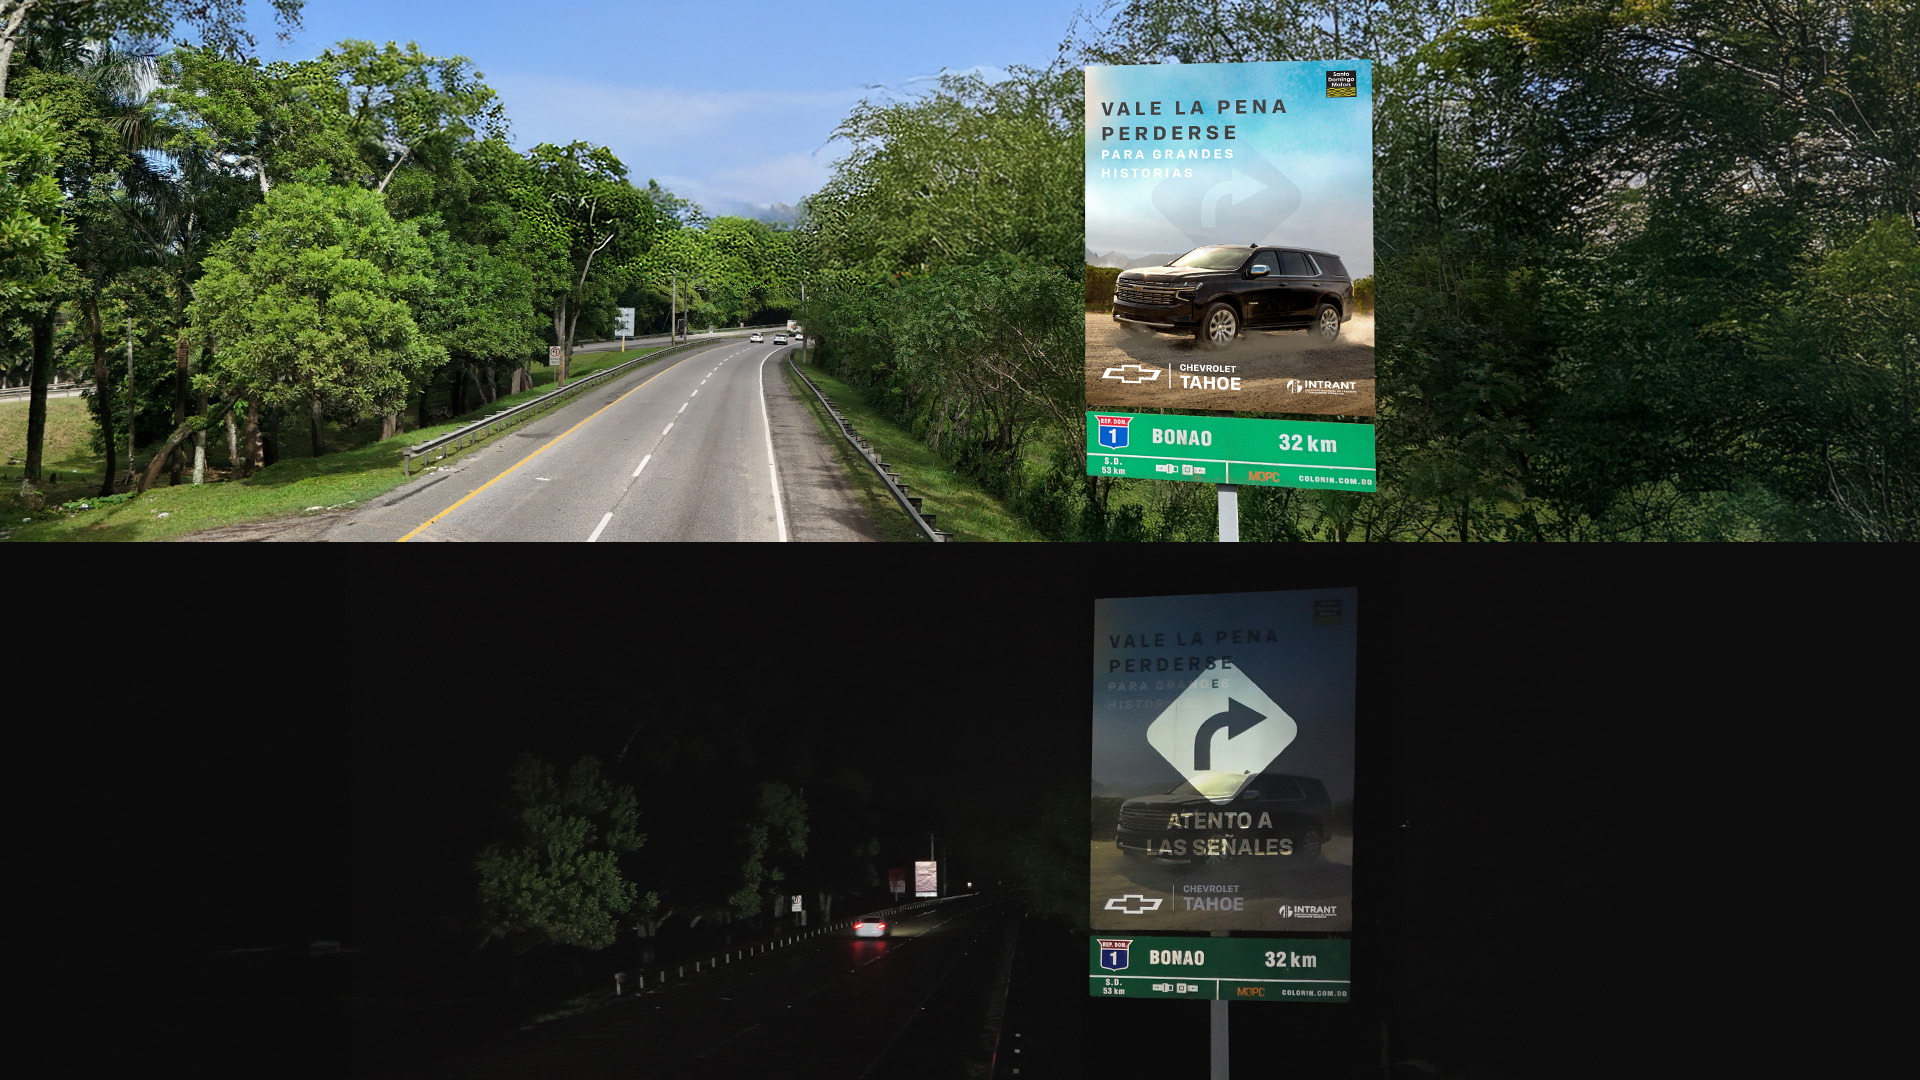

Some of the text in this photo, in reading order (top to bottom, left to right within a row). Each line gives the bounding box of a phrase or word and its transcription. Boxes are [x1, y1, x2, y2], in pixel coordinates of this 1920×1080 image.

[1102, 99, 1287, 116] VALE LA PENA
[1102, 125, 1237, 141] PERDERSE
[1102, 148, 1234, 160] PARA GRANDES
[1102, 168, 1193, 178] HISTORIAS
[1180, 364, 1236, 373] CHEVROLET
[1180, 375, 1241, 390] TAHOE
[1305, 380, 1356, 390] INTRANT
[1108, 428, 1117, 443] 1
[1152, 428, 1337, 453] BONAO 32 km
[1104, 457, 1123, 465] S.D.
[1102, 466, 1125, 475] 53 km
[1249, 471, 1372, 486] MOPC COLORIN.COM.DO
[1110, 629, 1278, 648] VALE LA PENA
[1109, 656, 1232, 673] PERDERSE
[1108, 680, 1148, 691] PARA
[1167, 812, 1273, 830] ATENTO A
[1146, 834, 1293, 857] LAS SEÑALES
[1183, 884, 1239, 893] CHEVROLET
[1183, 897, 1244, 911] TAHOE
[1294, 905, 1337, 914] INTRANT
[1110, 951, 1117, 966] 1
[1150, 949, 1317, 968] BONAO 32 km
[1105, 978, 1122, 986] S.D.
[1103, 987, 1125, 995] 53 km
[1237, 986, 1347, 997] MOPC COLORIN.COM.DO
